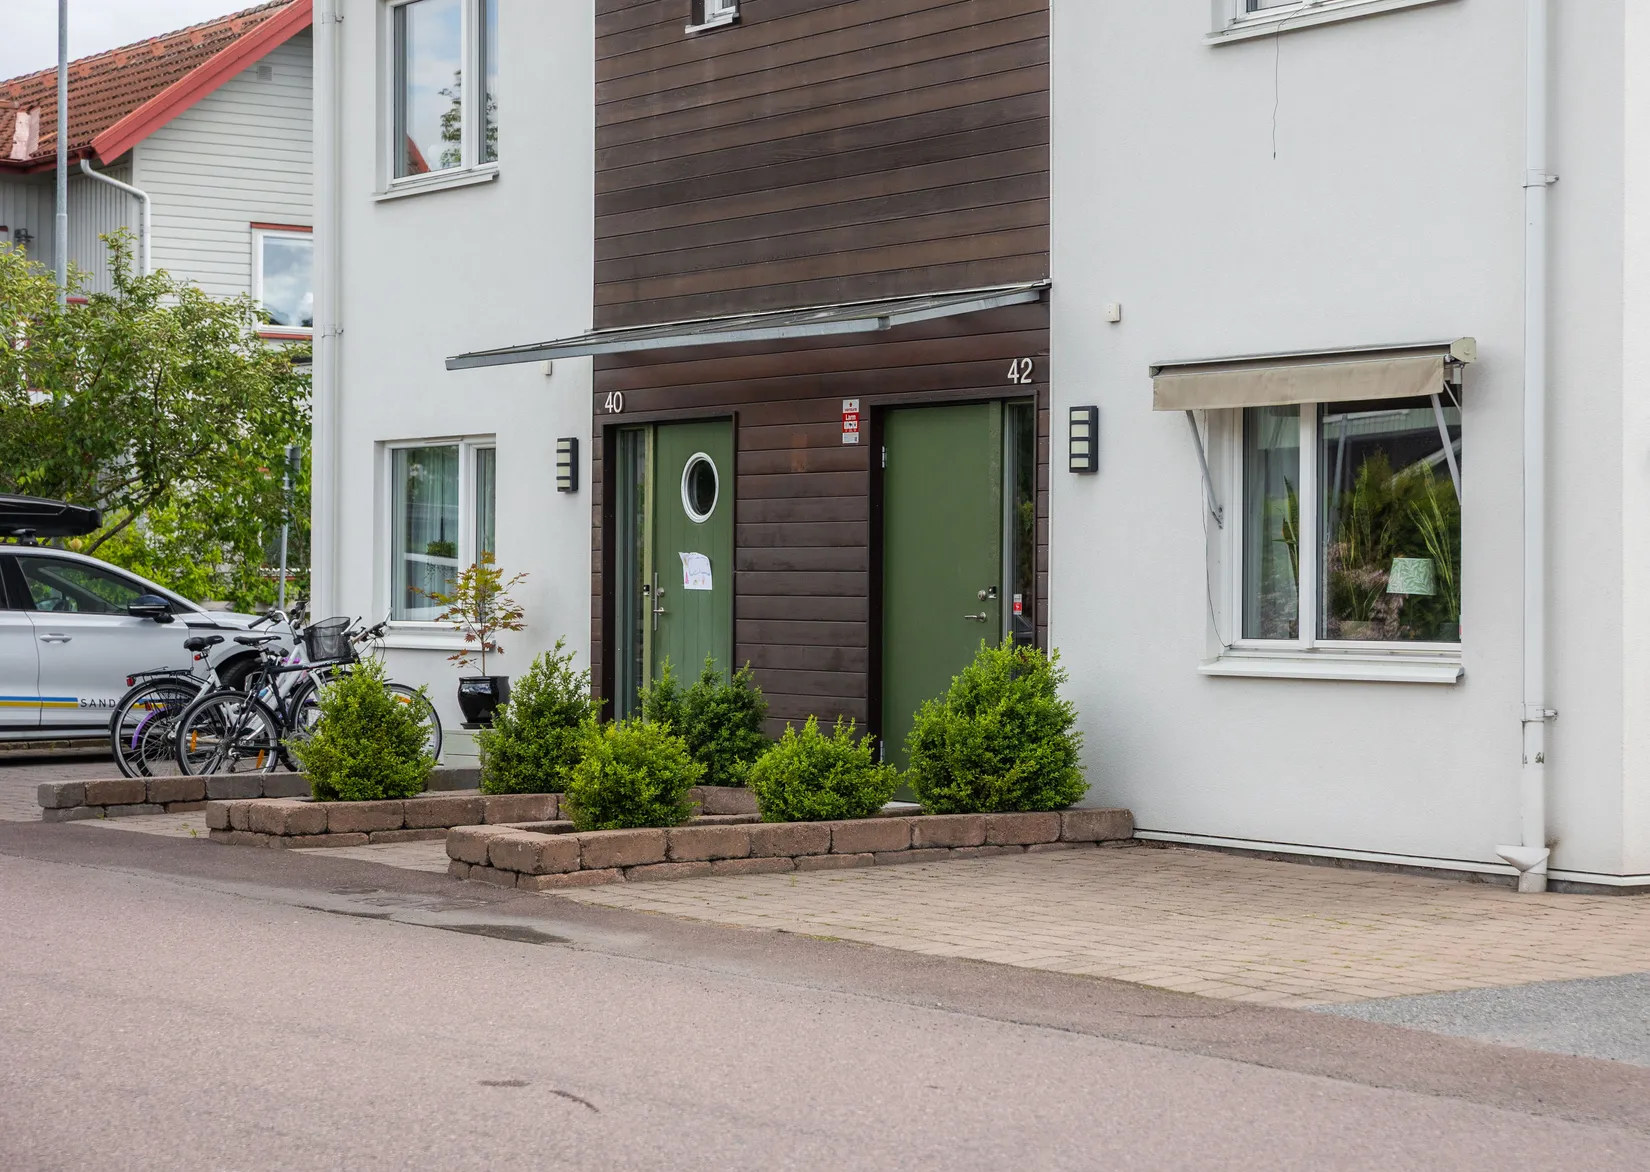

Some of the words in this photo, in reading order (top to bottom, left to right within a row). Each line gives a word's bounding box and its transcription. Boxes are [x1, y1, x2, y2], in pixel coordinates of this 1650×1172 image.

[1007, 357, 1033, 384] 42
[604, 391, 623, 413] 40
[80, 698, 117, 708] SAND
